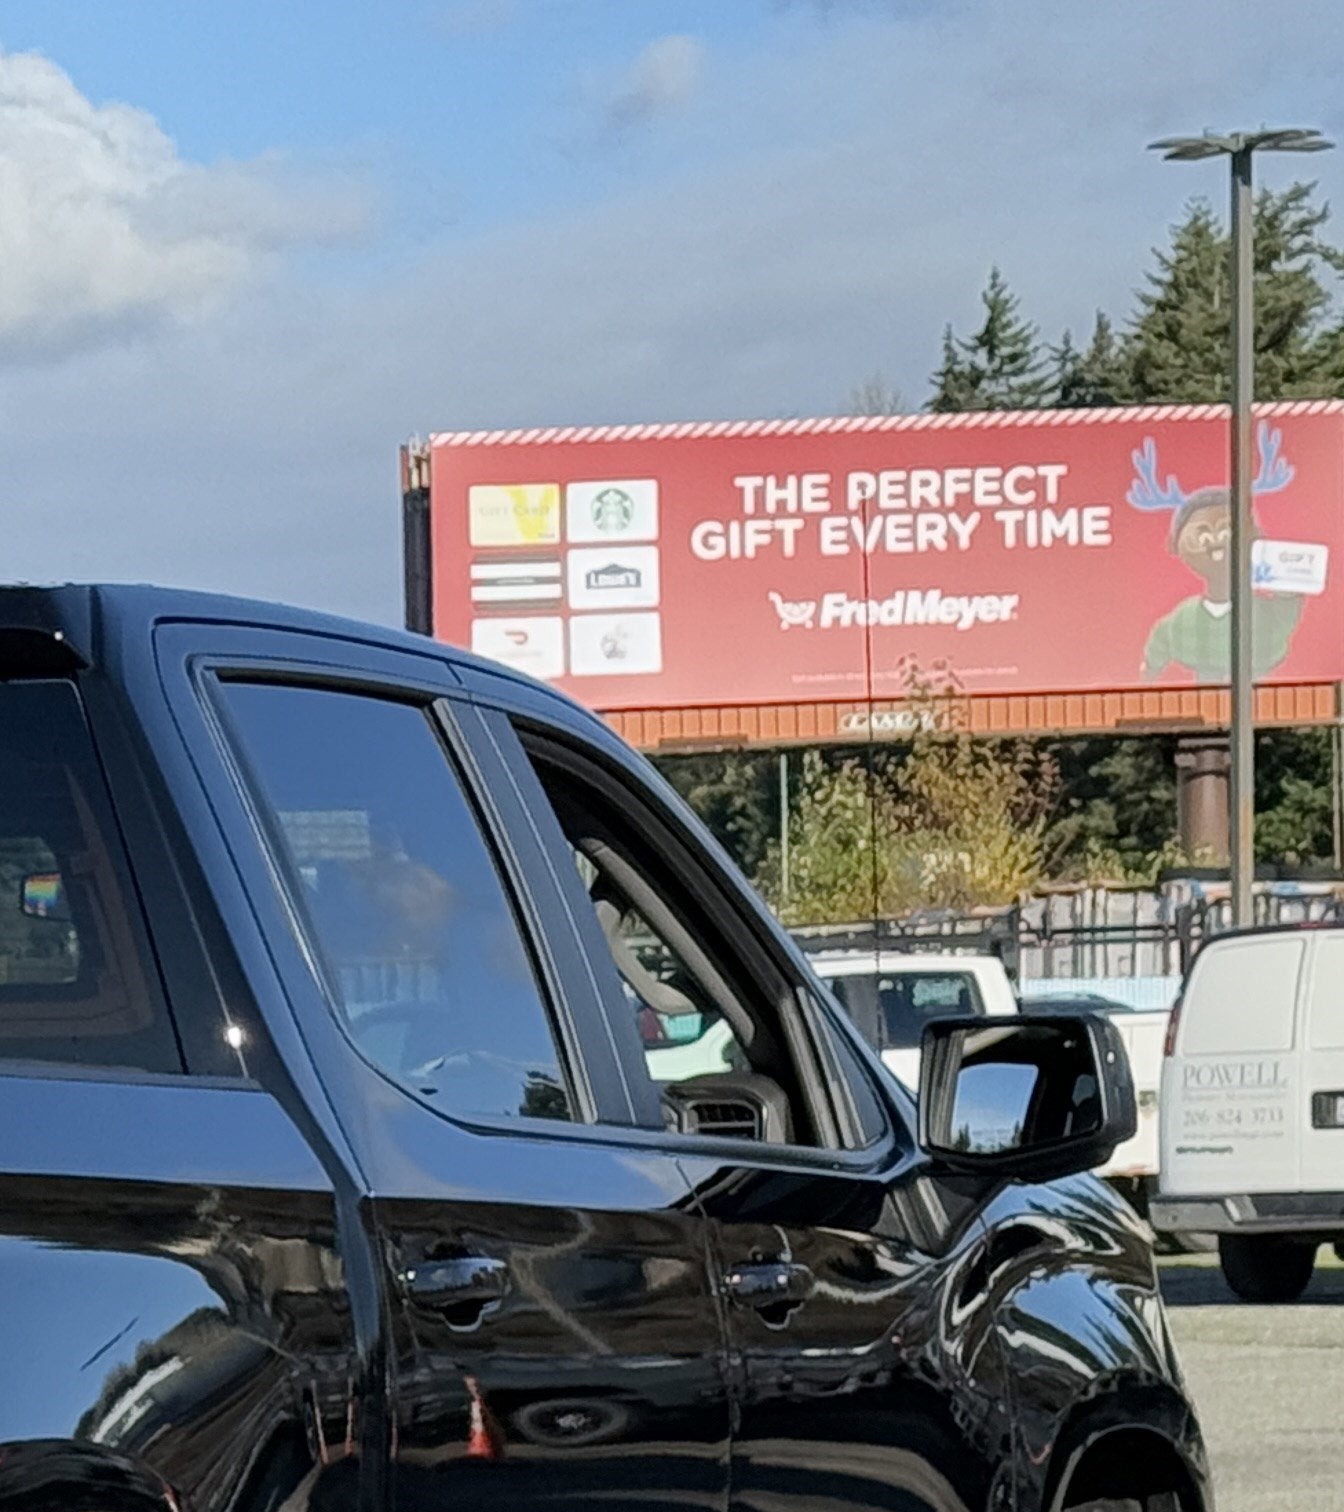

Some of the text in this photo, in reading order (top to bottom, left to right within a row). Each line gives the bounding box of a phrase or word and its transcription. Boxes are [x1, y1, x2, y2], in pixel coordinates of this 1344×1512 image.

[733, 464, 1068, 514] THE PERFECT
[690, 506, 1112, 561] GIFT EVERY TIME
[1183, 1061, 1288, 1088] POWELL
